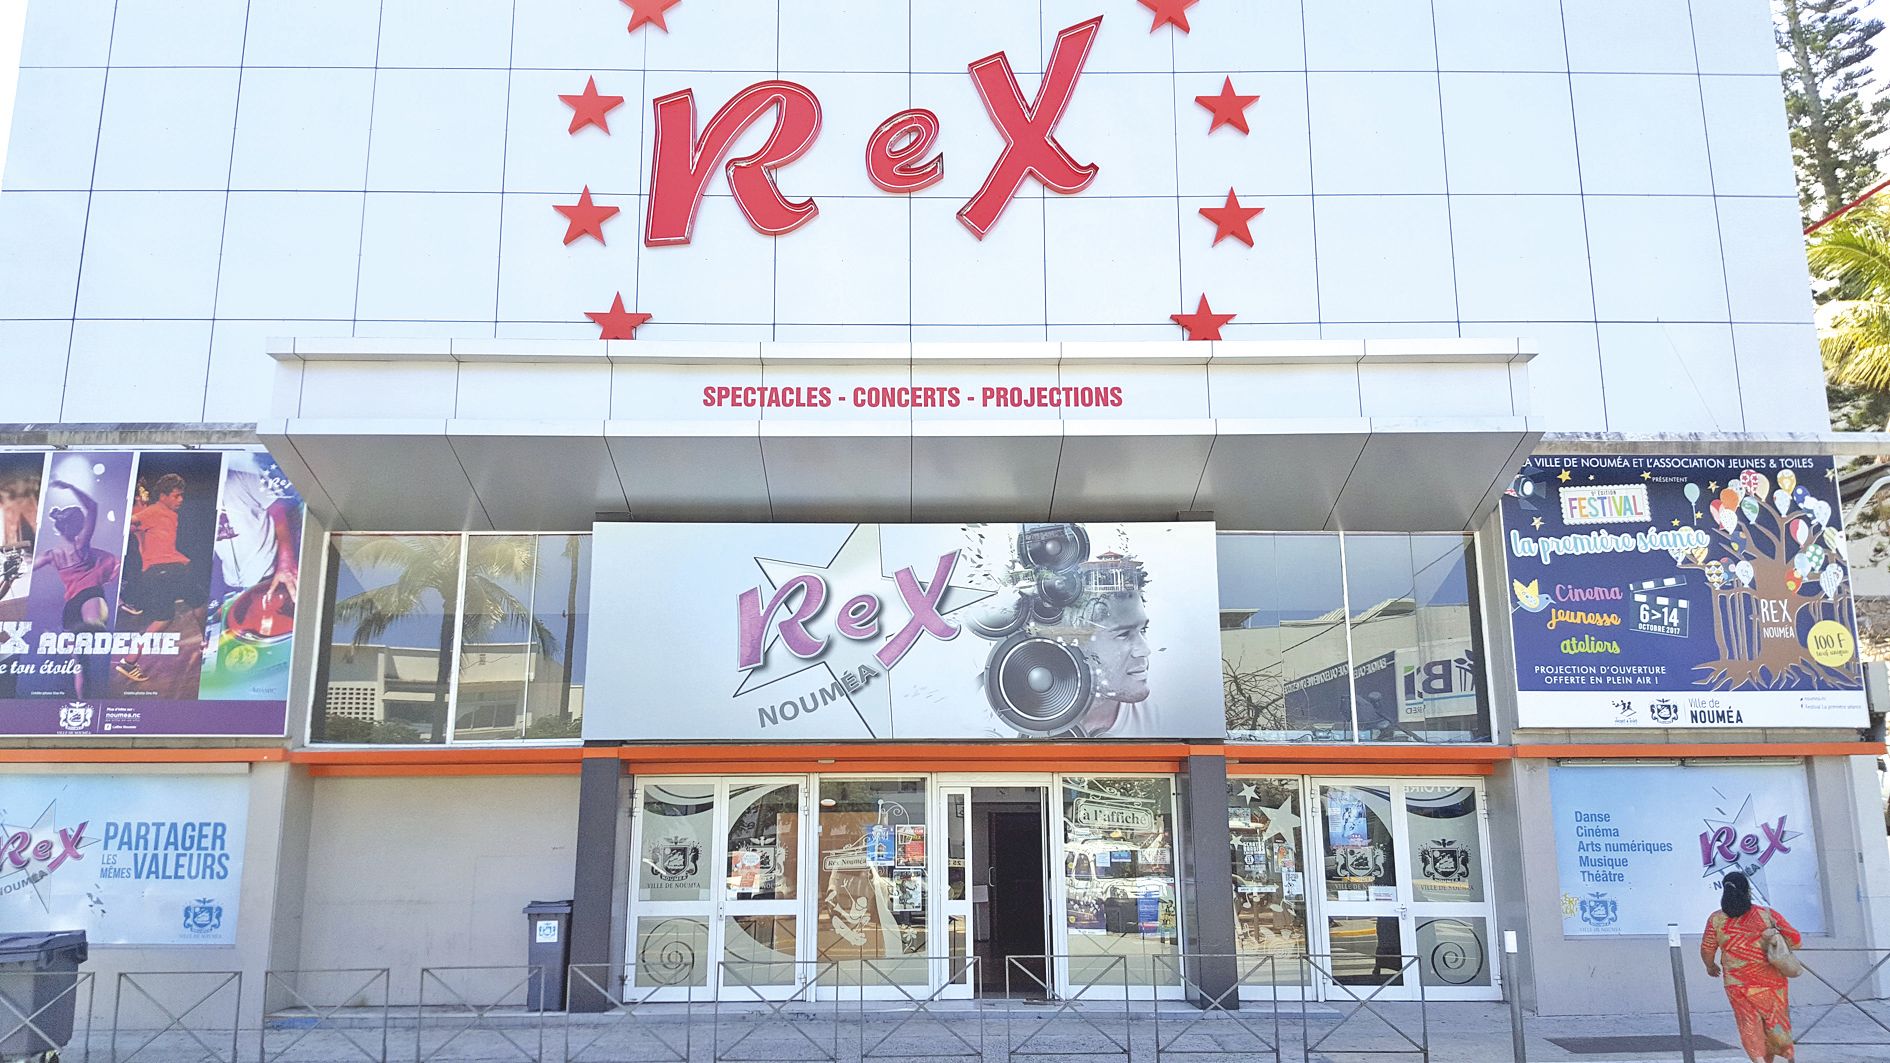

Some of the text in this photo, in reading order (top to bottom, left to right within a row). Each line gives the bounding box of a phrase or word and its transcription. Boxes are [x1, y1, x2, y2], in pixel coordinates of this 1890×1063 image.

[702, 386, 832, 408] SPECTACLES
[853, 386, 961, 408] CONCERTS
[982, 386, 1123, 408] PROJECTIONS
[1534, 457, 1561, 468] VILLE
[1564, 457, 1578, 468] DE
[1581, 455, 1631, 468] NOUMÉA
[1633, 457, 1644, 468] ET
[1646, 457, 1725, 469] L'ASSOCIATION
[1728, 457, 1766, 469] JEUNES
[1768, 457, 1777, 469] &
[1779, 457, 1814, 469] TOILES
[1651, 475, 1688, 483] PRÉSENTENT
[1567, 495, 1644, 518] FESTIVAL
[1510, 526, 1710, 564] la première séance
[1760, 598, 1793, 623] REX
[1547, 607, 1621, 630] jeunesse
[1638, 622, 1681, 635] OCTOBRE 2017
[1763, 625, 1795, 639] NOUMÉA
[0, 621, 181, 655] X ACADEMIE
[1560, 634, 1621, 655] ateliers
[1813, 632, 1846, 650] 100 F
[10, 661, 35, 675] ton
[40, 658, 82, 675] étoile
[1534, 665, 1667, 674] PROJECTION D'OUVERTURE
[1544, 675, 1586, 684] OFFERTE
[1590, 675, 1603, 684] EN
[1606, 675, 1633, 684] PLEIN
[1636, 675, 1652, 684] AIR
[758, 663, 879, 729] NOUMÉA
[1688, 698, 1720, 709] Ville de
[1690, 705, 1744, 724] NOUMÉA
[1082, 809, 1147, 825] à l'affiche
[1574, 810, 1611, 823] Danse
[102, 821, 228, 851] PARTAGER
[1576, 825, 1620, 838] Cinéma
[1577, 839, 1673, 854] Arts numériques
[101, 854, 118, 865] LES
[132, 852, 231, 880] VALEURS
[1579, 856, 1629, 870] Musique
[100, 866, 132, 879] MÊMES
[1580, 869, 1625, 883] Théâtre
